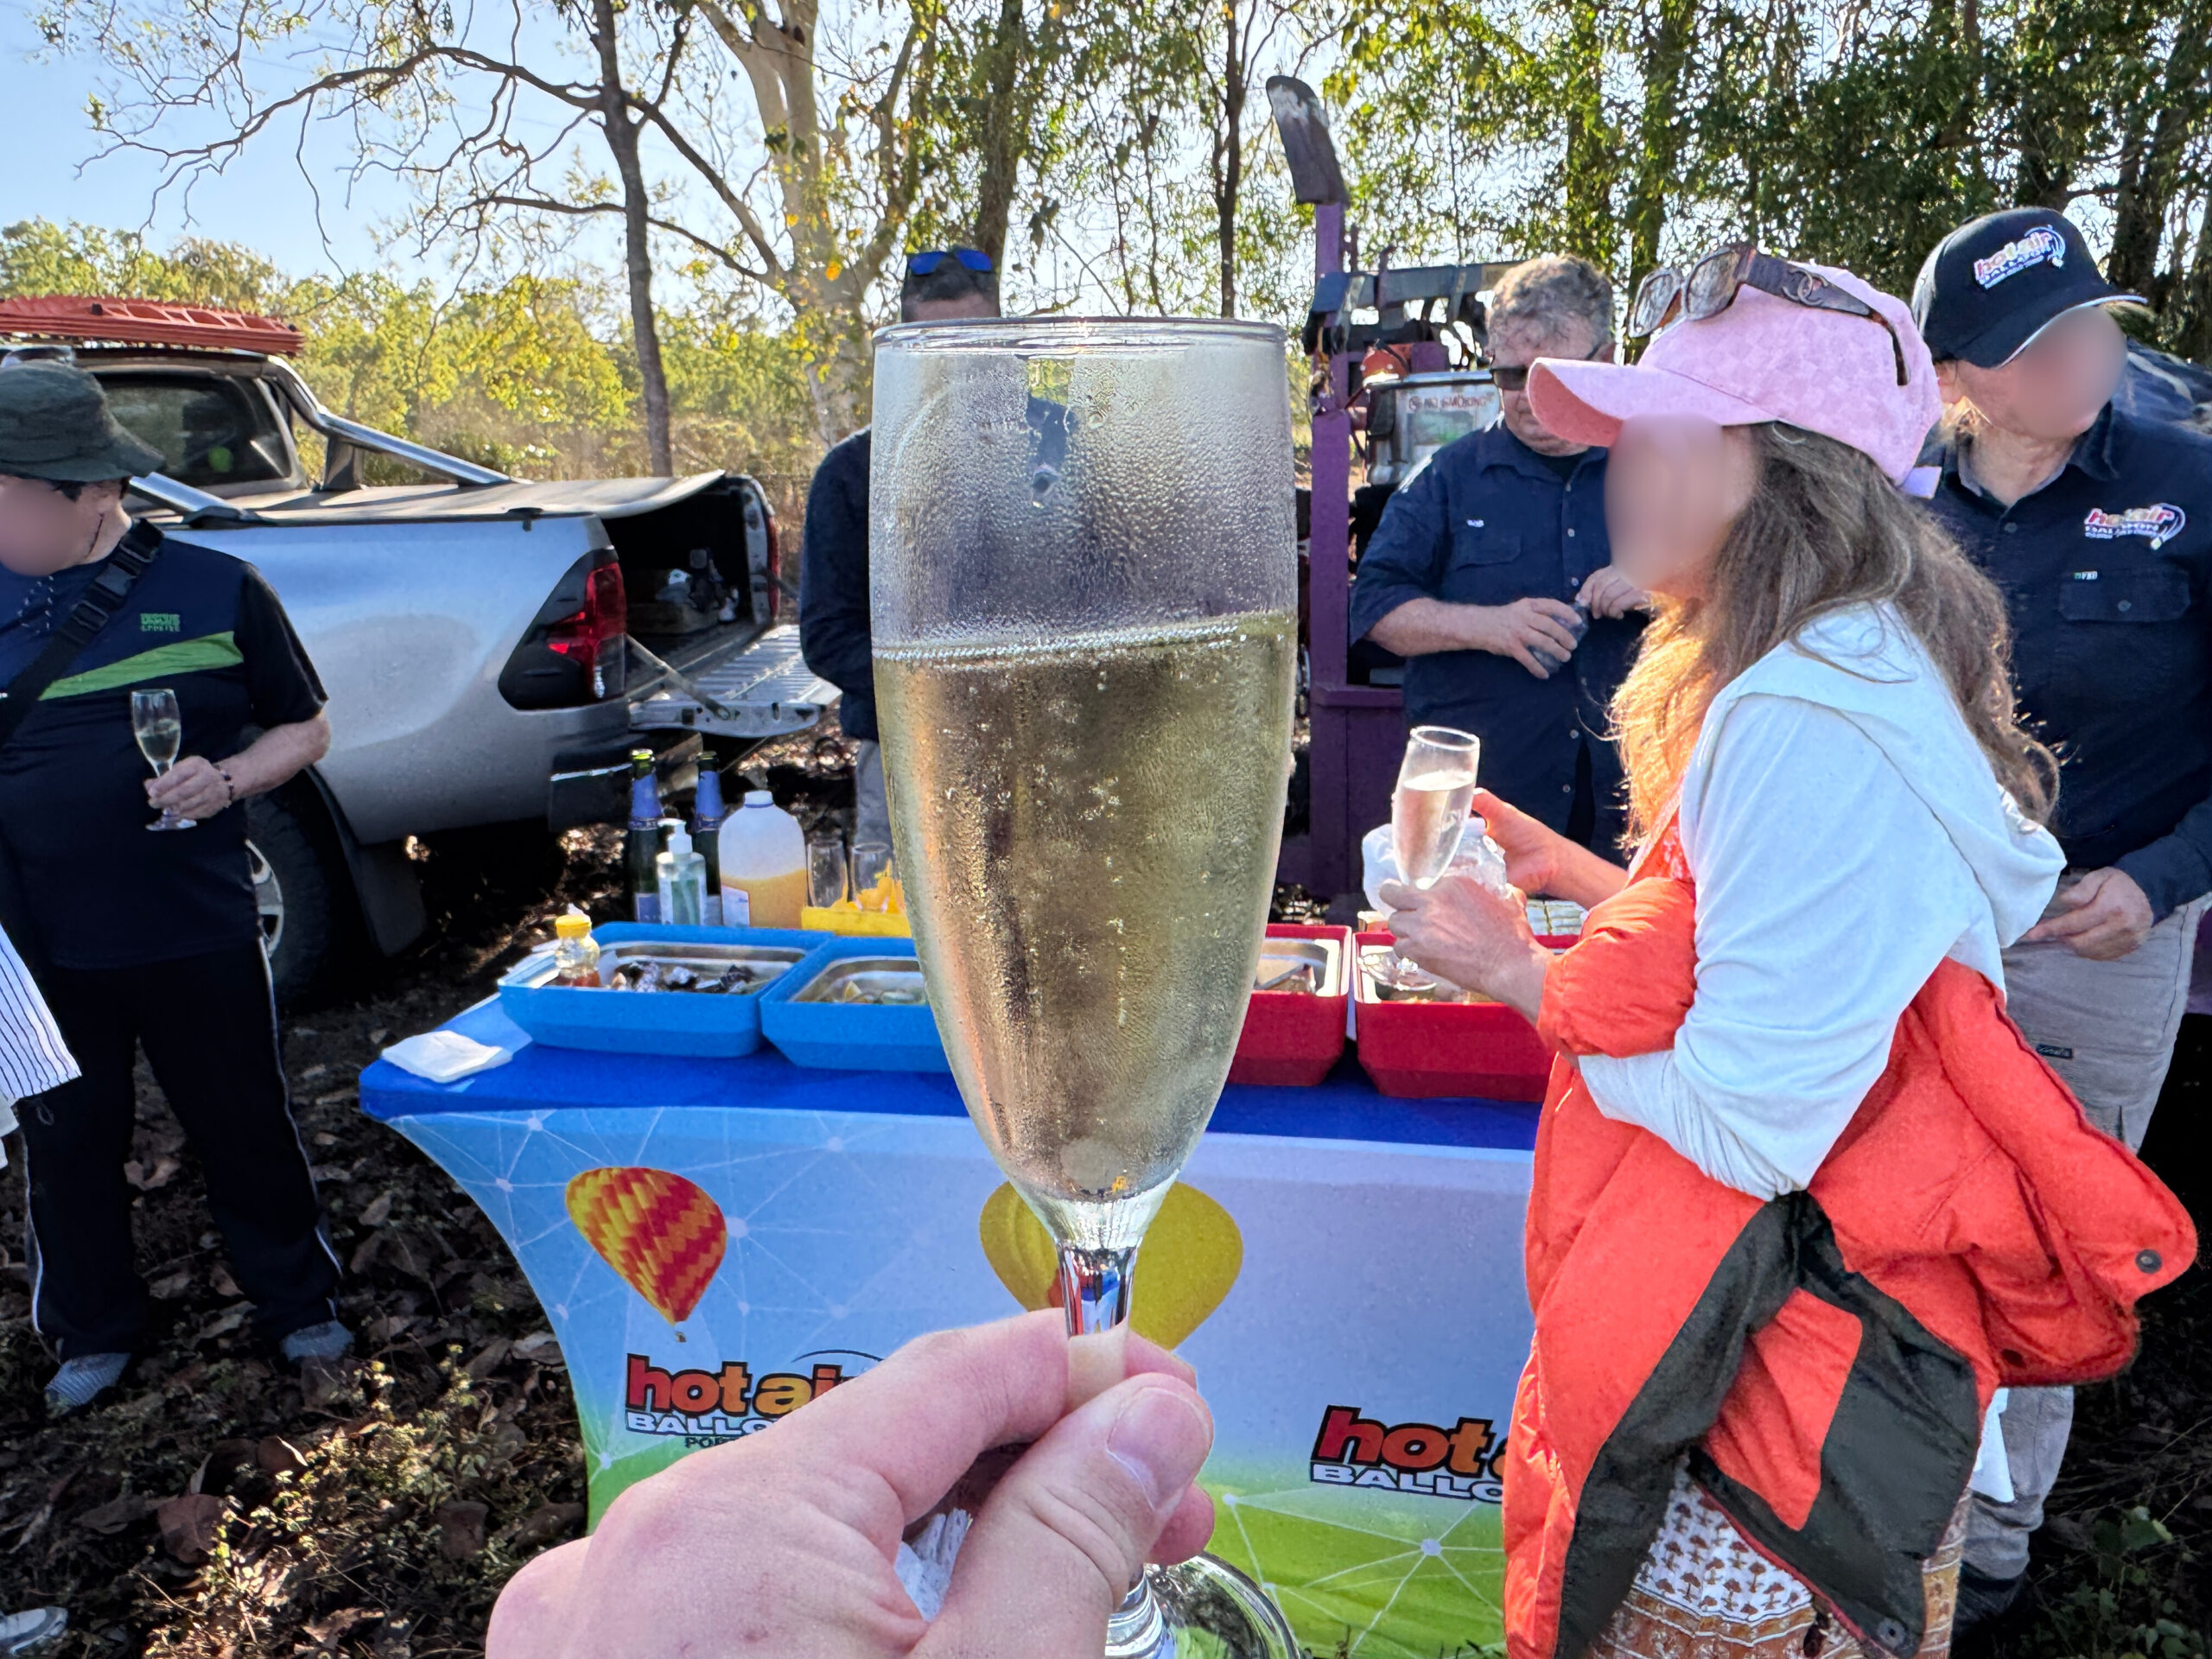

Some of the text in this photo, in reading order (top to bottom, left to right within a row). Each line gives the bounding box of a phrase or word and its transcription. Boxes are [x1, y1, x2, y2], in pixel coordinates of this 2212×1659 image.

[626, 1353, 856, 1416] hot ai
[1311, 1405, 1497, 1478] hot
